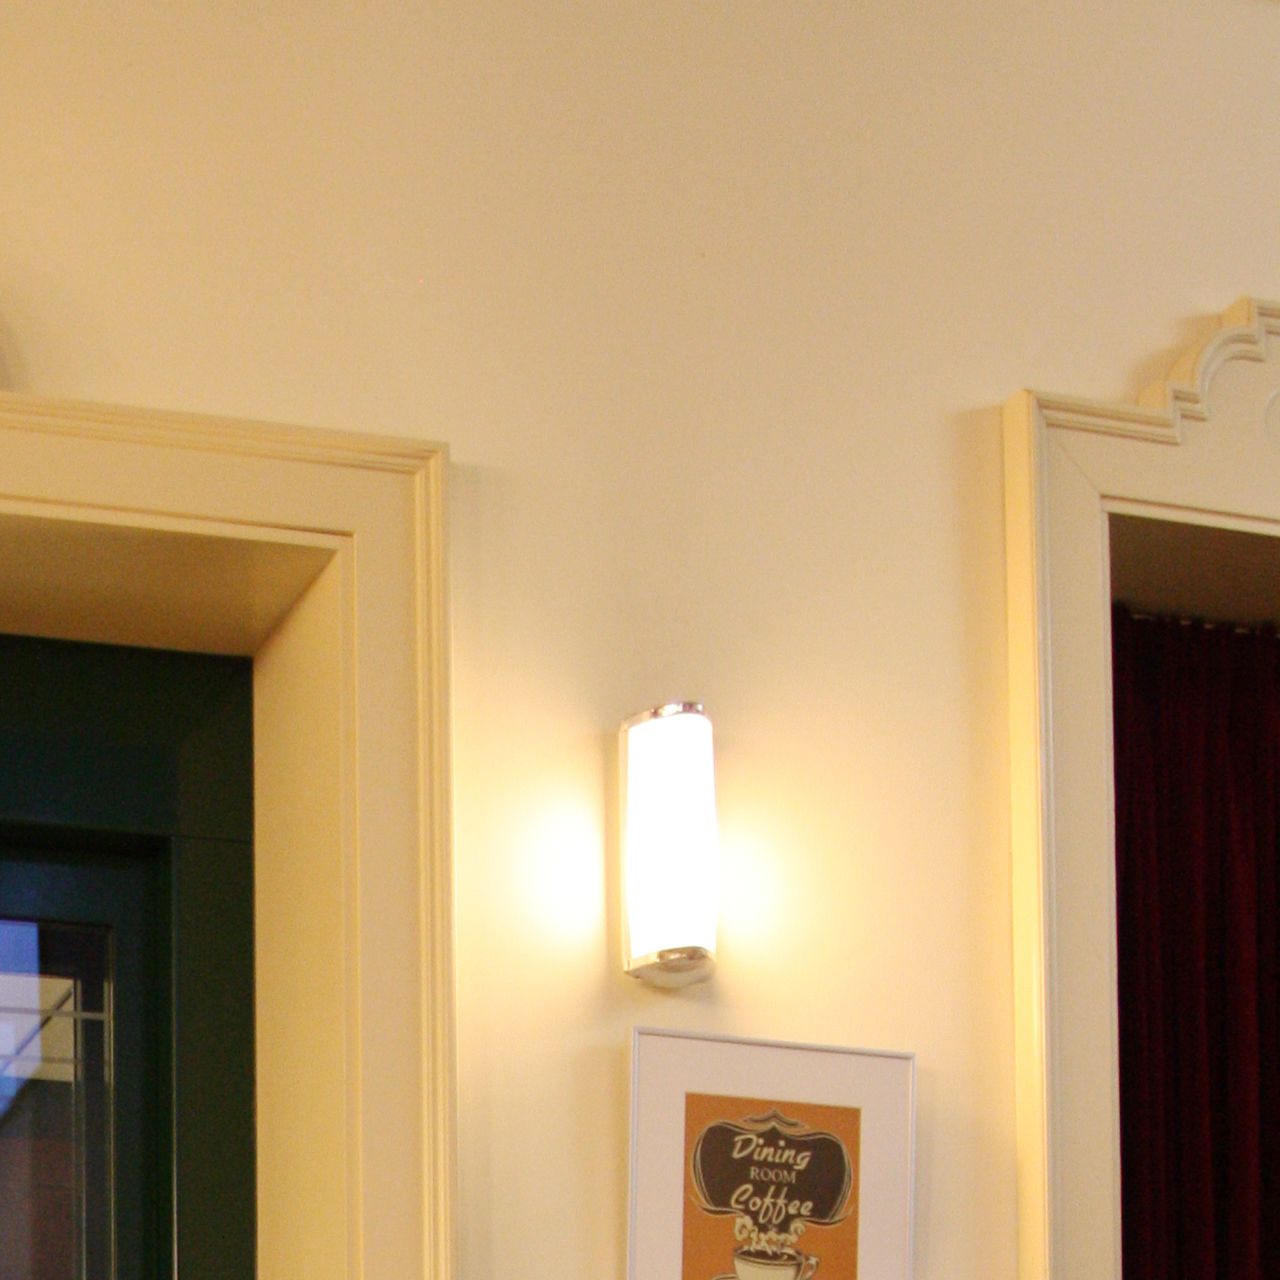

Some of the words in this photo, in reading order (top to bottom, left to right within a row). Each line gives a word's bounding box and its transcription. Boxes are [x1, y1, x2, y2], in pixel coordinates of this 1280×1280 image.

[732, 1134, 812, 1170] Dining
[750, 1166, 797, 1184] ROOM
[731, 1183, 813, 1224] Coffee
